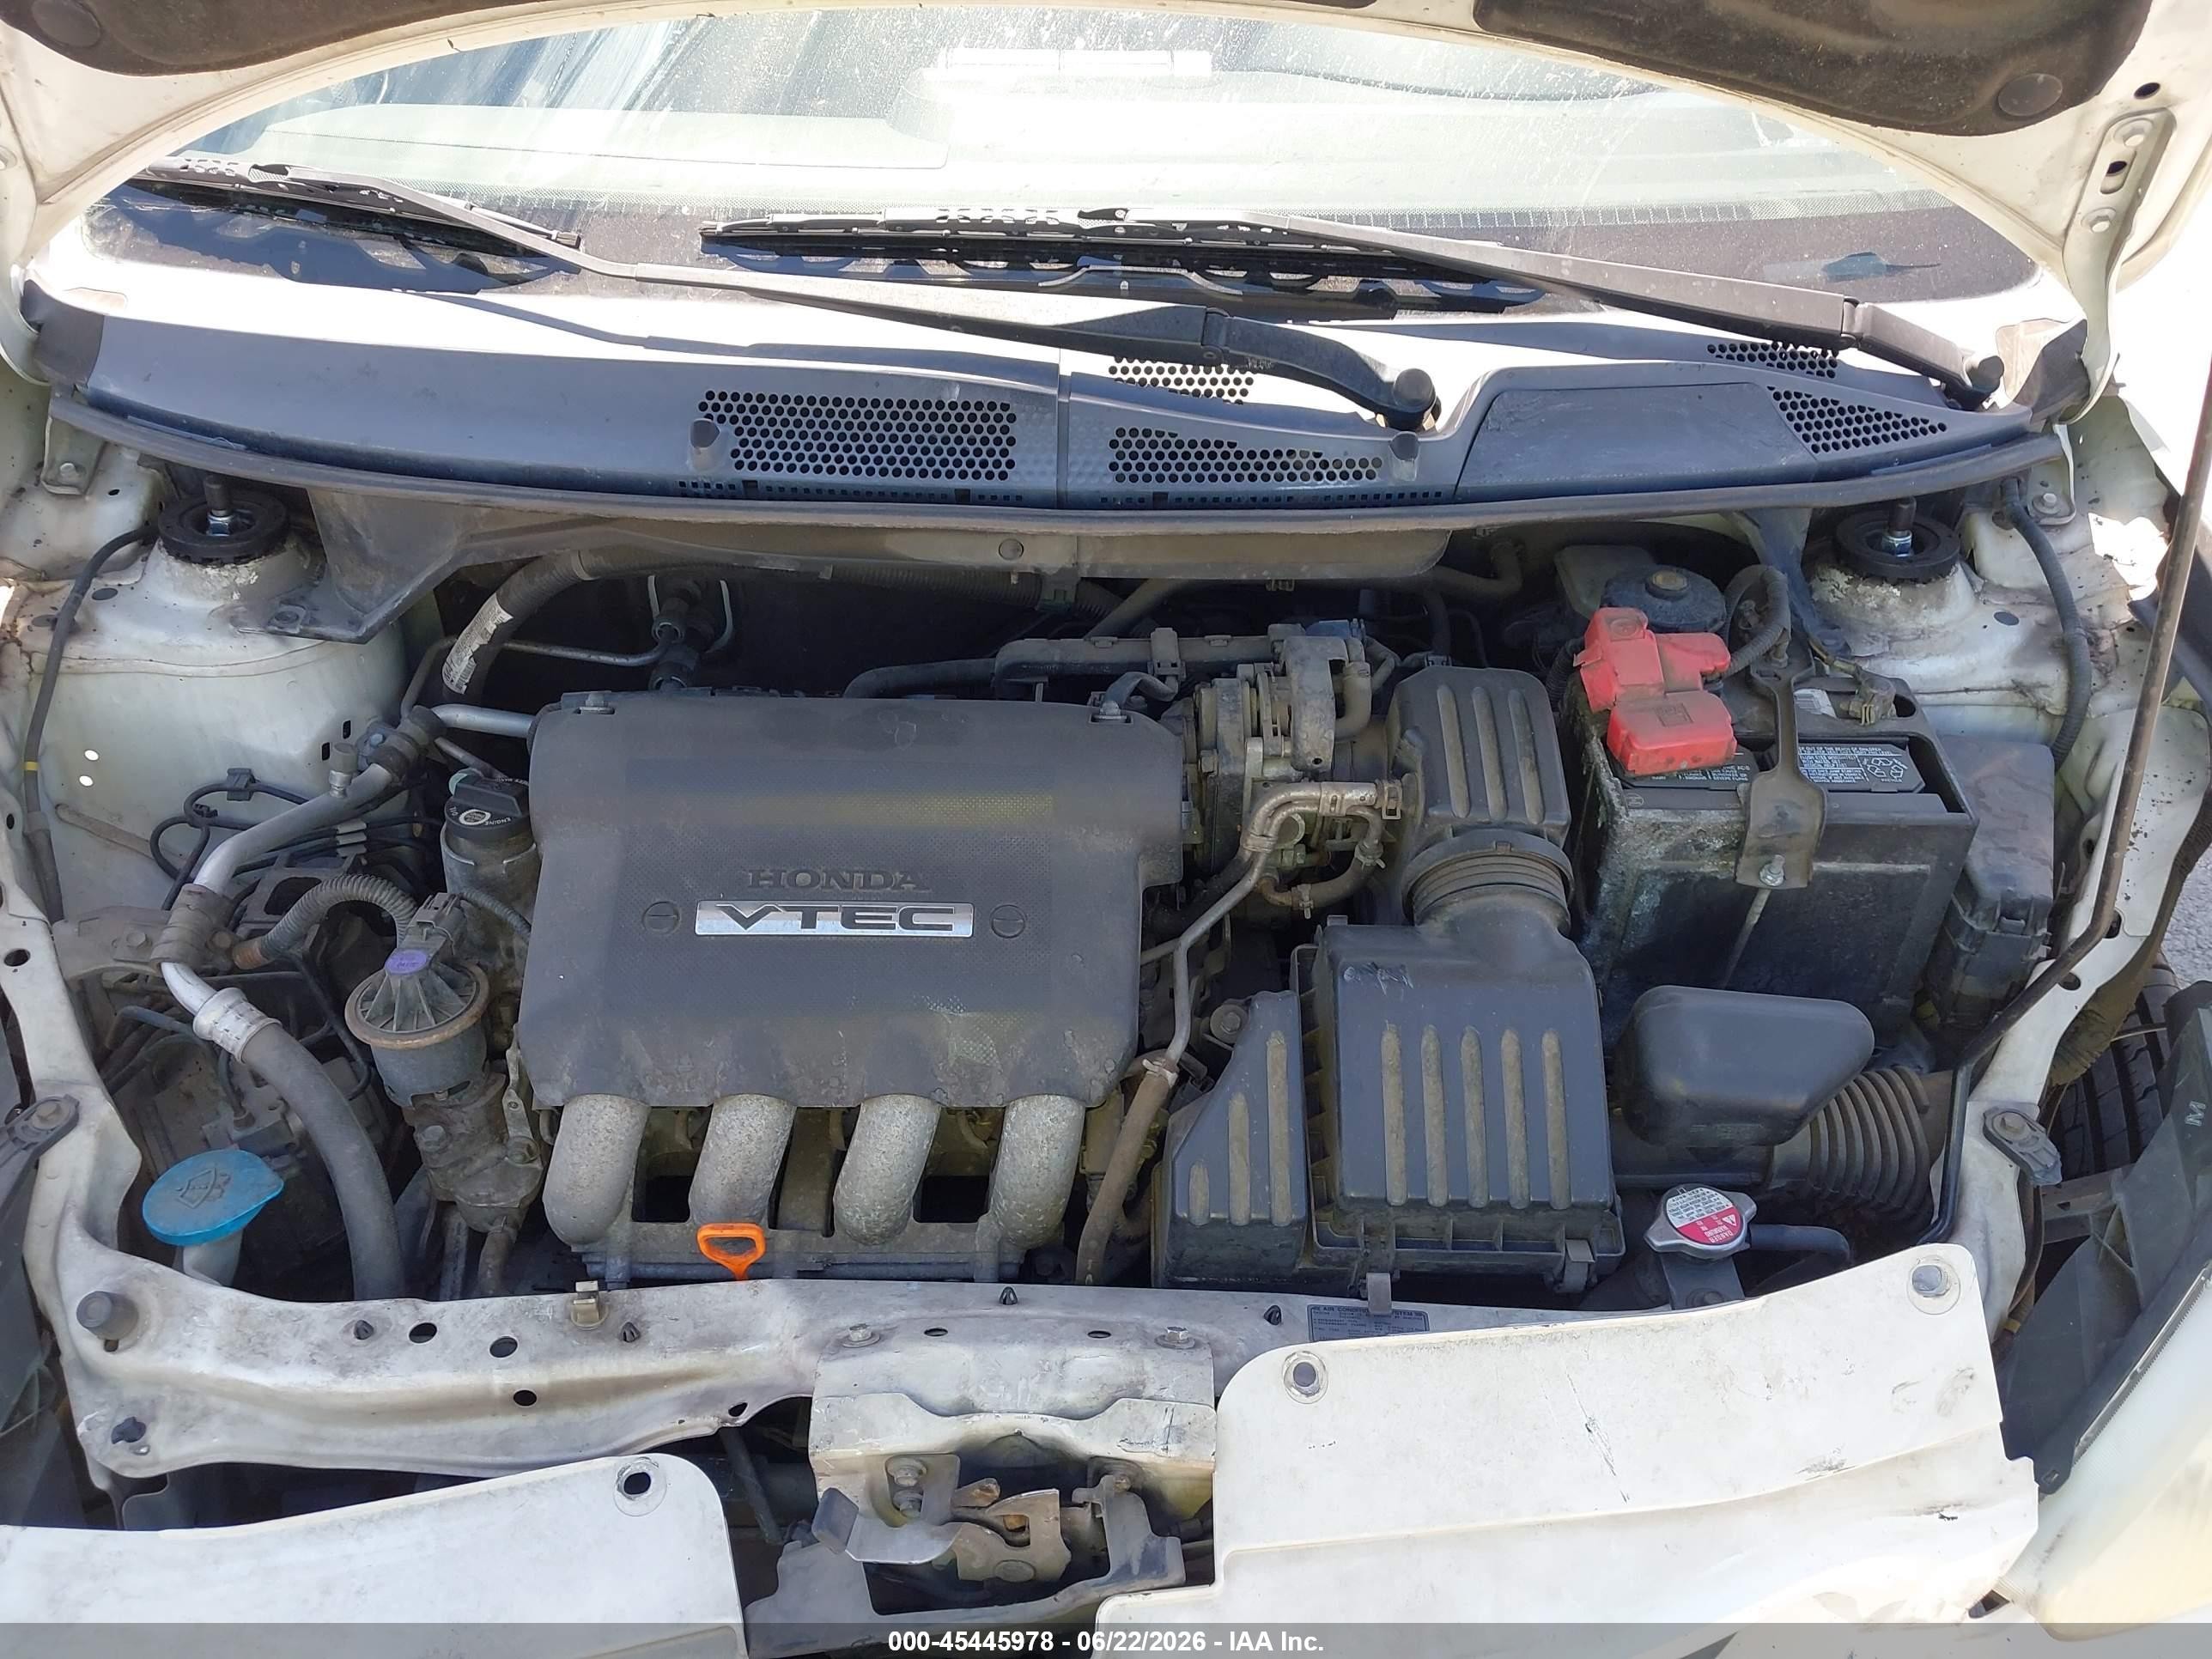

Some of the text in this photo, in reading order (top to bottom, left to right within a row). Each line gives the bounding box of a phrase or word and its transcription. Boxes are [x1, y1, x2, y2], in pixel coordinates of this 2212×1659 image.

[449, 806, 459, 817] OIL
[484, 817, 512, 825] ENGINE
[748, 869, 930, 891] HONDA
[715, 904, 954, 931] VTEC
[1709, 1230, 1734, 1243] DANGER
